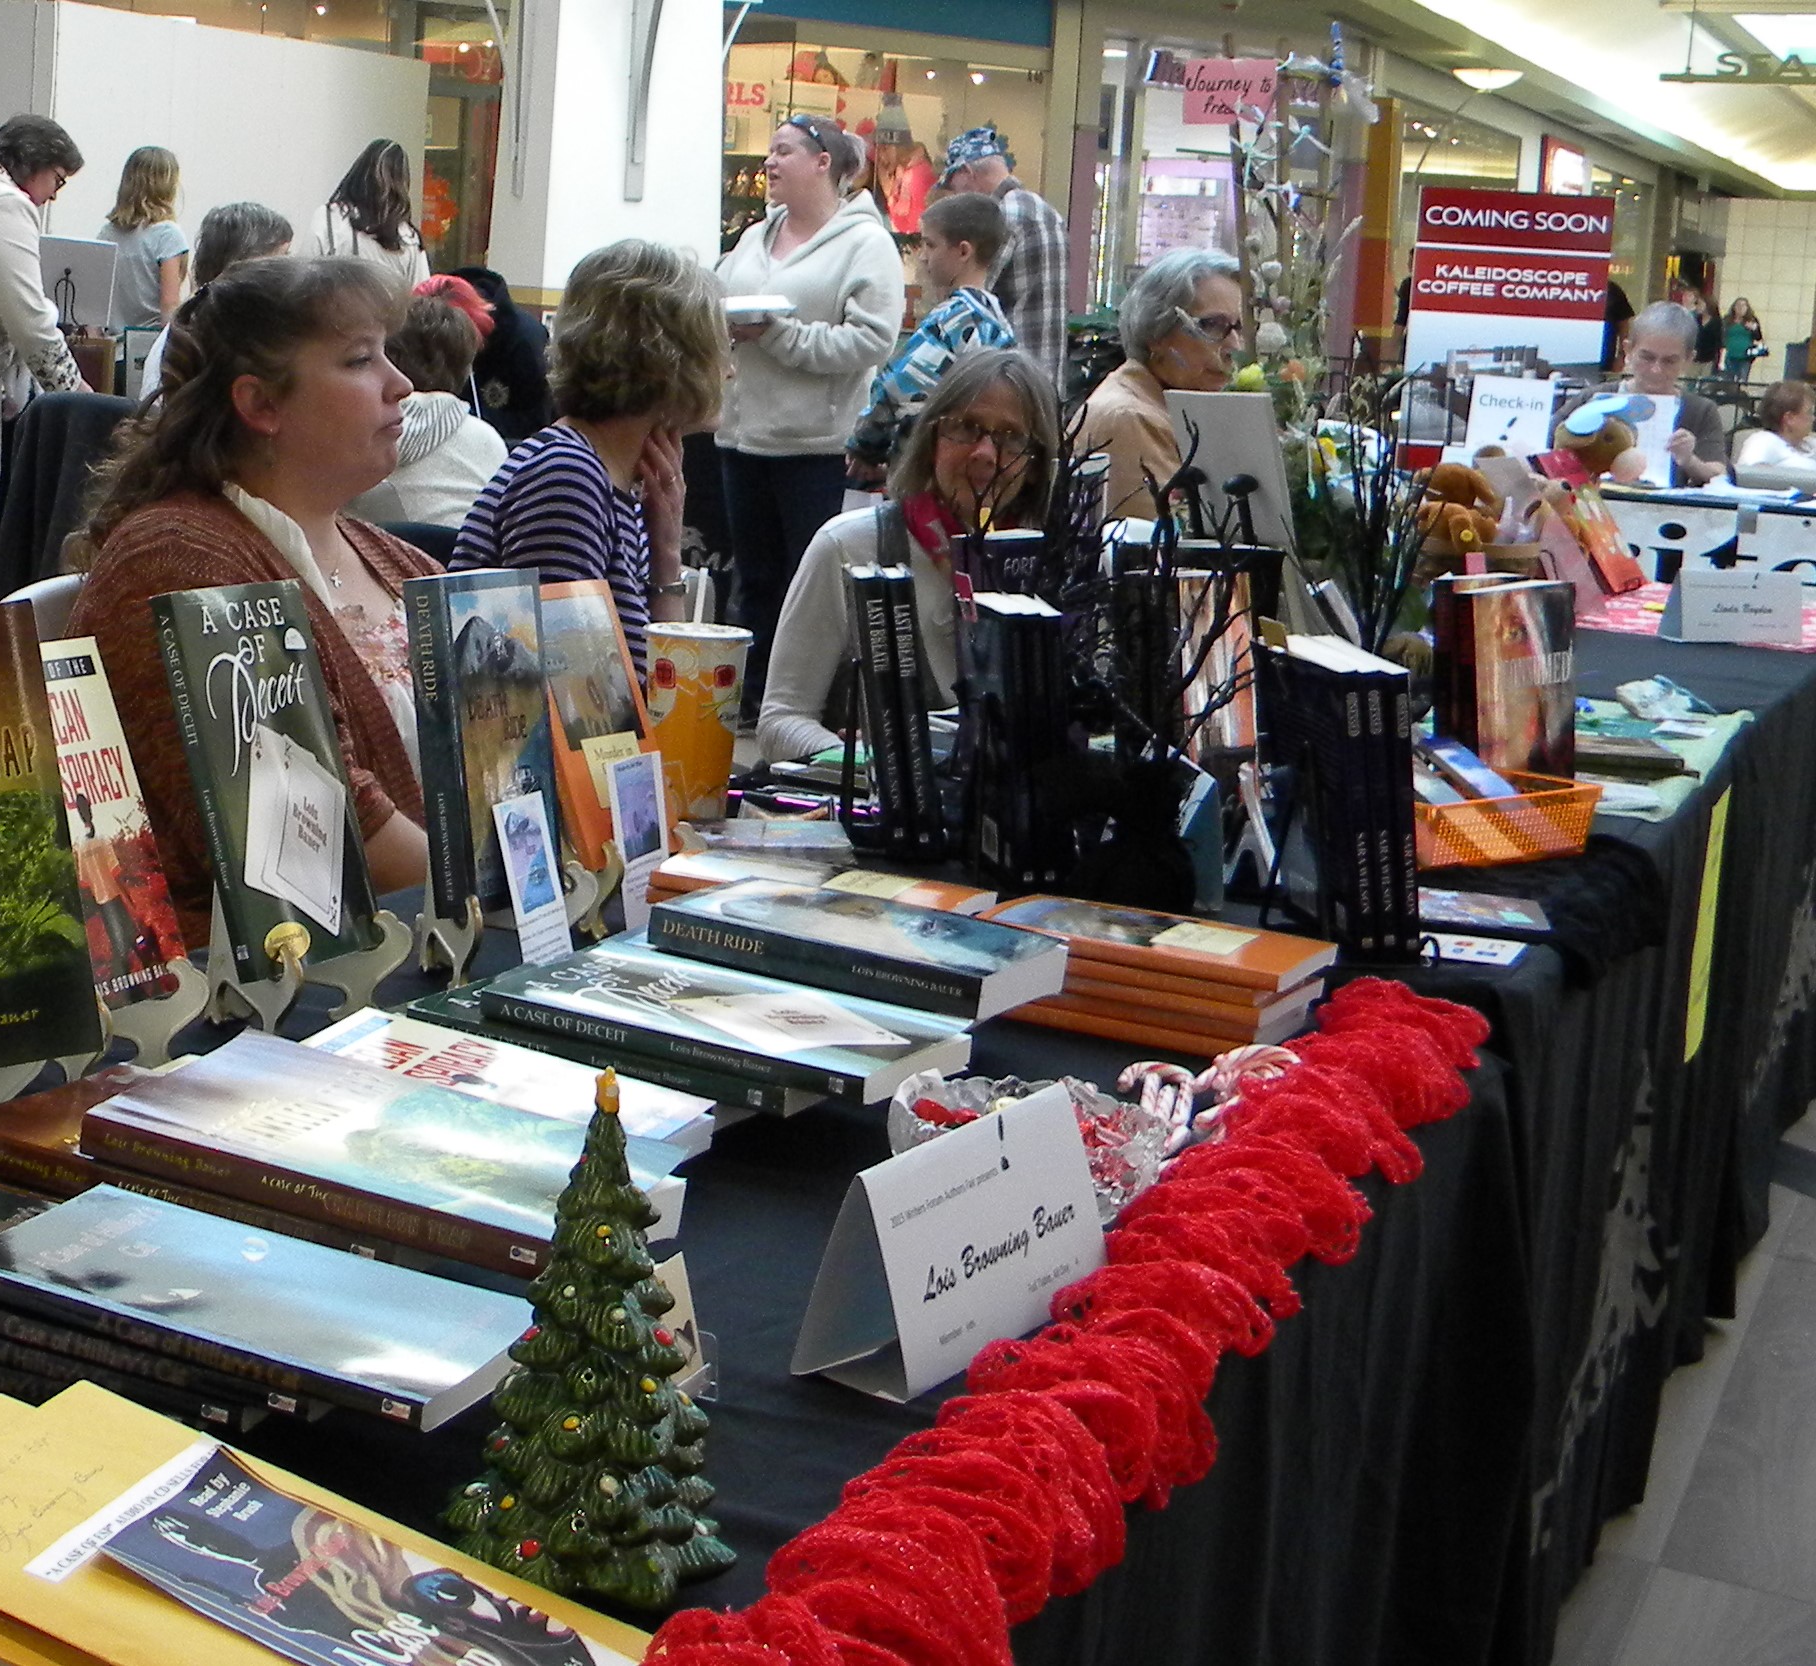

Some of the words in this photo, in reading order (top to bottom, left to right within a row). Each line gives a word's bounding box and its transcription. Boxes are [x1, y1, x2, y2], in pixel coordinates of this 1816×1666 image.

[1186, 66, 1253, 97] Journey
[1260, 77, 1271, 93] to
[1425, 206, 1528, 230] COMING
[1534, 212, 1608, 234] SOON
[1417, 281, 1495, 296] COFFEE
[1502, 285, 1604, 302] COMPANY
[1435, 264, 1589, 286] KALEIDOSCOPE
[1479, 394, 1544, 410] Check-in
[159, 615, 169, 626] A
[202, 606, 219, 636] A
[226, 597, 284, 631] CASE
[416, 595, 434, 657] DEATH
[867, 599, 884, 626] LAST
[894, 605, 912, 631] LAST
[163, 630, 177, 665] CASE
[239, 633, 265, 663] OF
[47, 662, 61, 679] OF
[66, 658, 87, 675] THE
[172, 667, 183, 685] OF
[424, 659, 438, 703] RIDE
[47, 689, 91, 746] CAN
[176, 687, 200, 747] DECEIT
[205, 650, 305, 778] Deceit
[662, 919, 721, 945] DEATH
[723, 931, 765, 956] RIDE
[111, 967, 152, 992] BROWNING
[525, 980, 559, 991] A
[551, 956, 629, 982] CASE
[851, 964, 875, 977] LOIS
[876, 969, 929, 992] BROWNING
[930, 982, 963, 997] BAUER
[500, 1003, 511, 1017] A
[513, 1006, 550, 1027] CASE
[552, 1016, 573, 1030] OF
[575, 1019, 628, 1044] DECEIT
[669, 1040, 693, 1053] Lois
[694, 1046, 740, 1068] Browning
[742, 1057, 773, 1073] Bauer
[260, 1175, 268, 1185] A
[269, 1176, 293, 1192] CASE
[294, 1180, 307, 1194] OF
[923, 1263, 957, 1303] Lois
[960, 1244, 1030, 1279] Browning
[1033, 1203, 1075, 1239] Bauer
[189, 1484, 218, 1507] Read
[215, 1472, 230, 1490] by
[205, 1482, 251, 1518] Stephanie
[57, 1547, 84, 1569] CASE
[81, 1537, 97, 1551] OF
[115, 1502, 144, 1526] AUDIO
[141, 1493, 158, 1507] ON
[154, 1484, 169, 1498] CD
[167, 1466, 193, 1489] SELLS
[232, 1500, 263, 1522] Brush
[349, 1612, 439, 1663] Case
